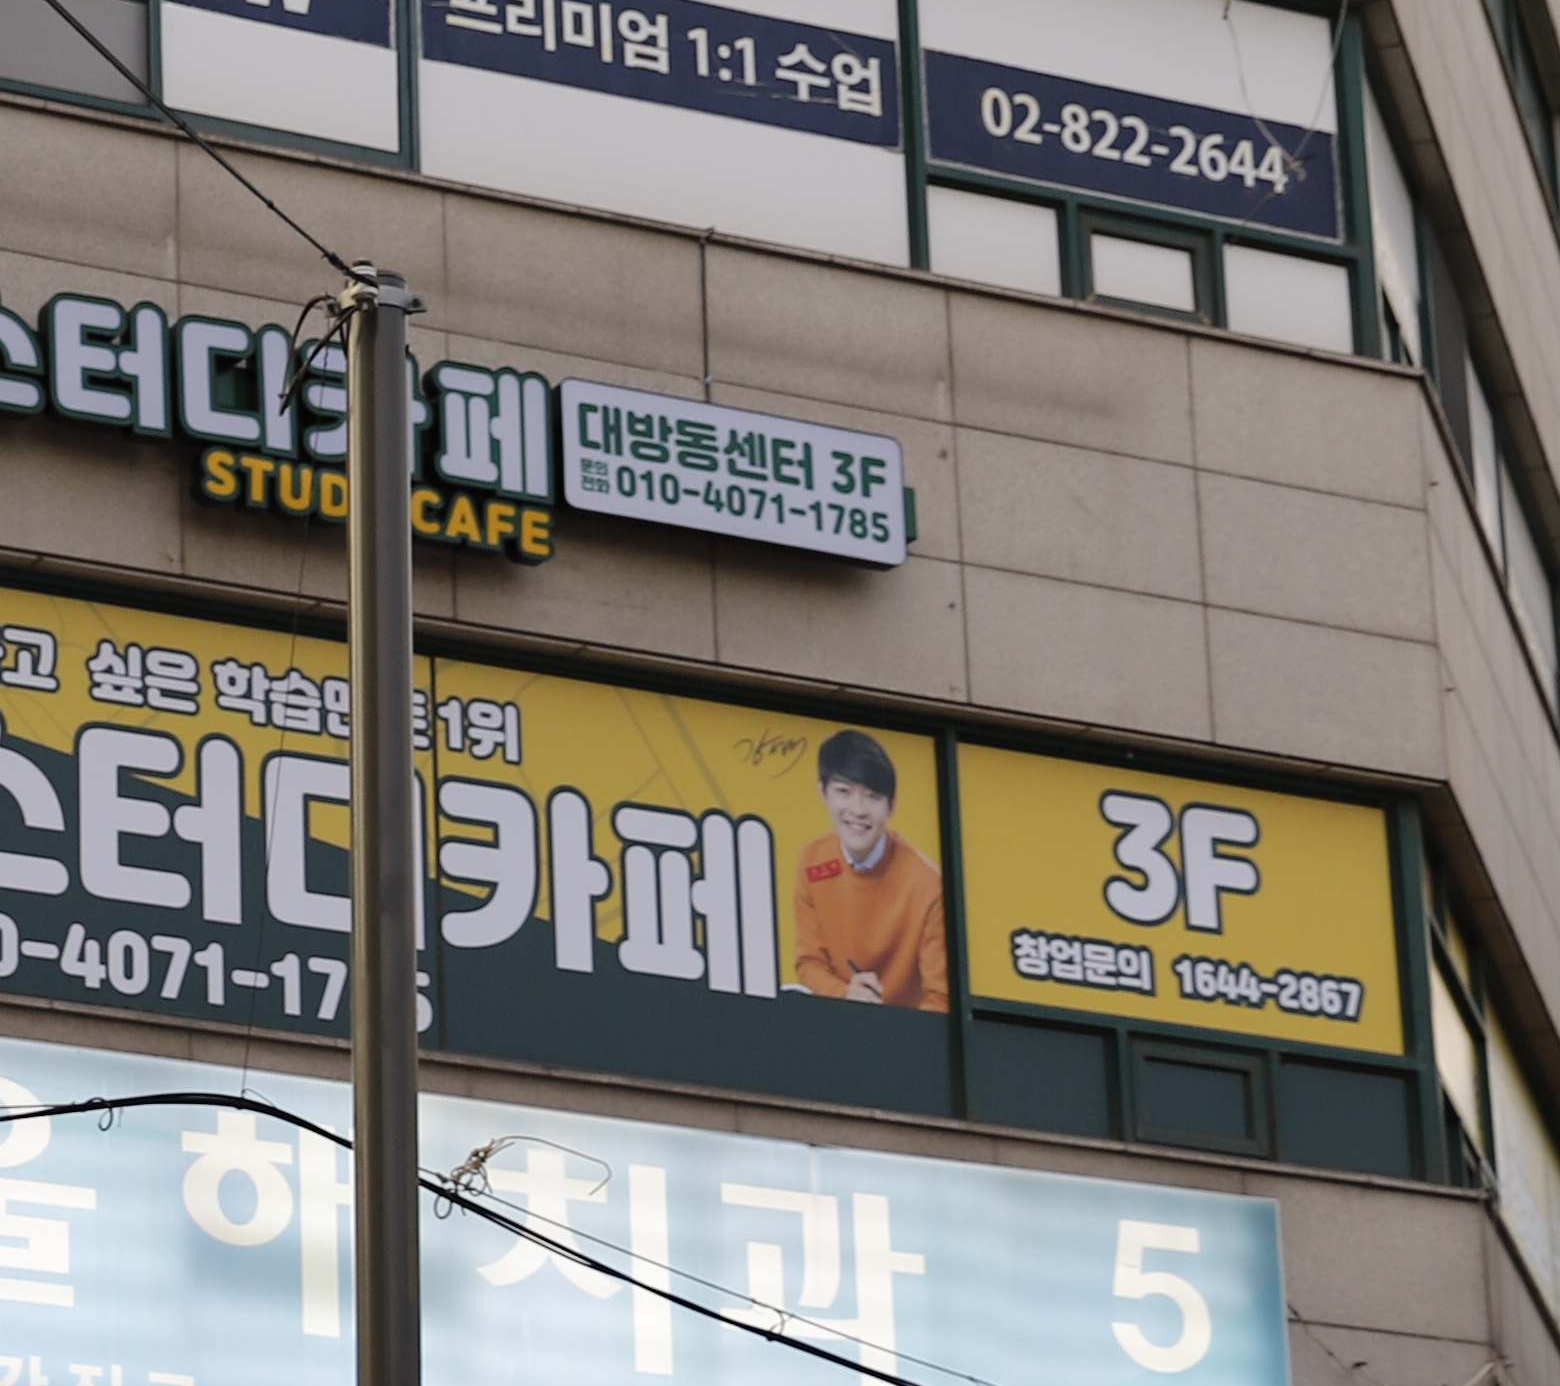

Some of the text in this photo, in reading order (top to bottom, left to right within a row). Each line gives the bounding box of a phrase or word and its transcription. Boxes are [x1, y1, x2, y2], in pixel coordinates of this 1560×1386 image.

[686, 25, 762, 87] 1:1
[774, 40, 884, 117] 수업
[980, 87, 1291, 194] 02-822-2644
[576, 400, 889, 500] 대방동센터 3F
[202, 449, 554, 558] STUD CAFE
[614, 463, 890, 544] 010-4071-1785
[87, 640, 200, 714] 싶은
[1101, 791, 1261, 933] 3F
[1012, 928, 1364, 1022] 창업문의 1644-2867
